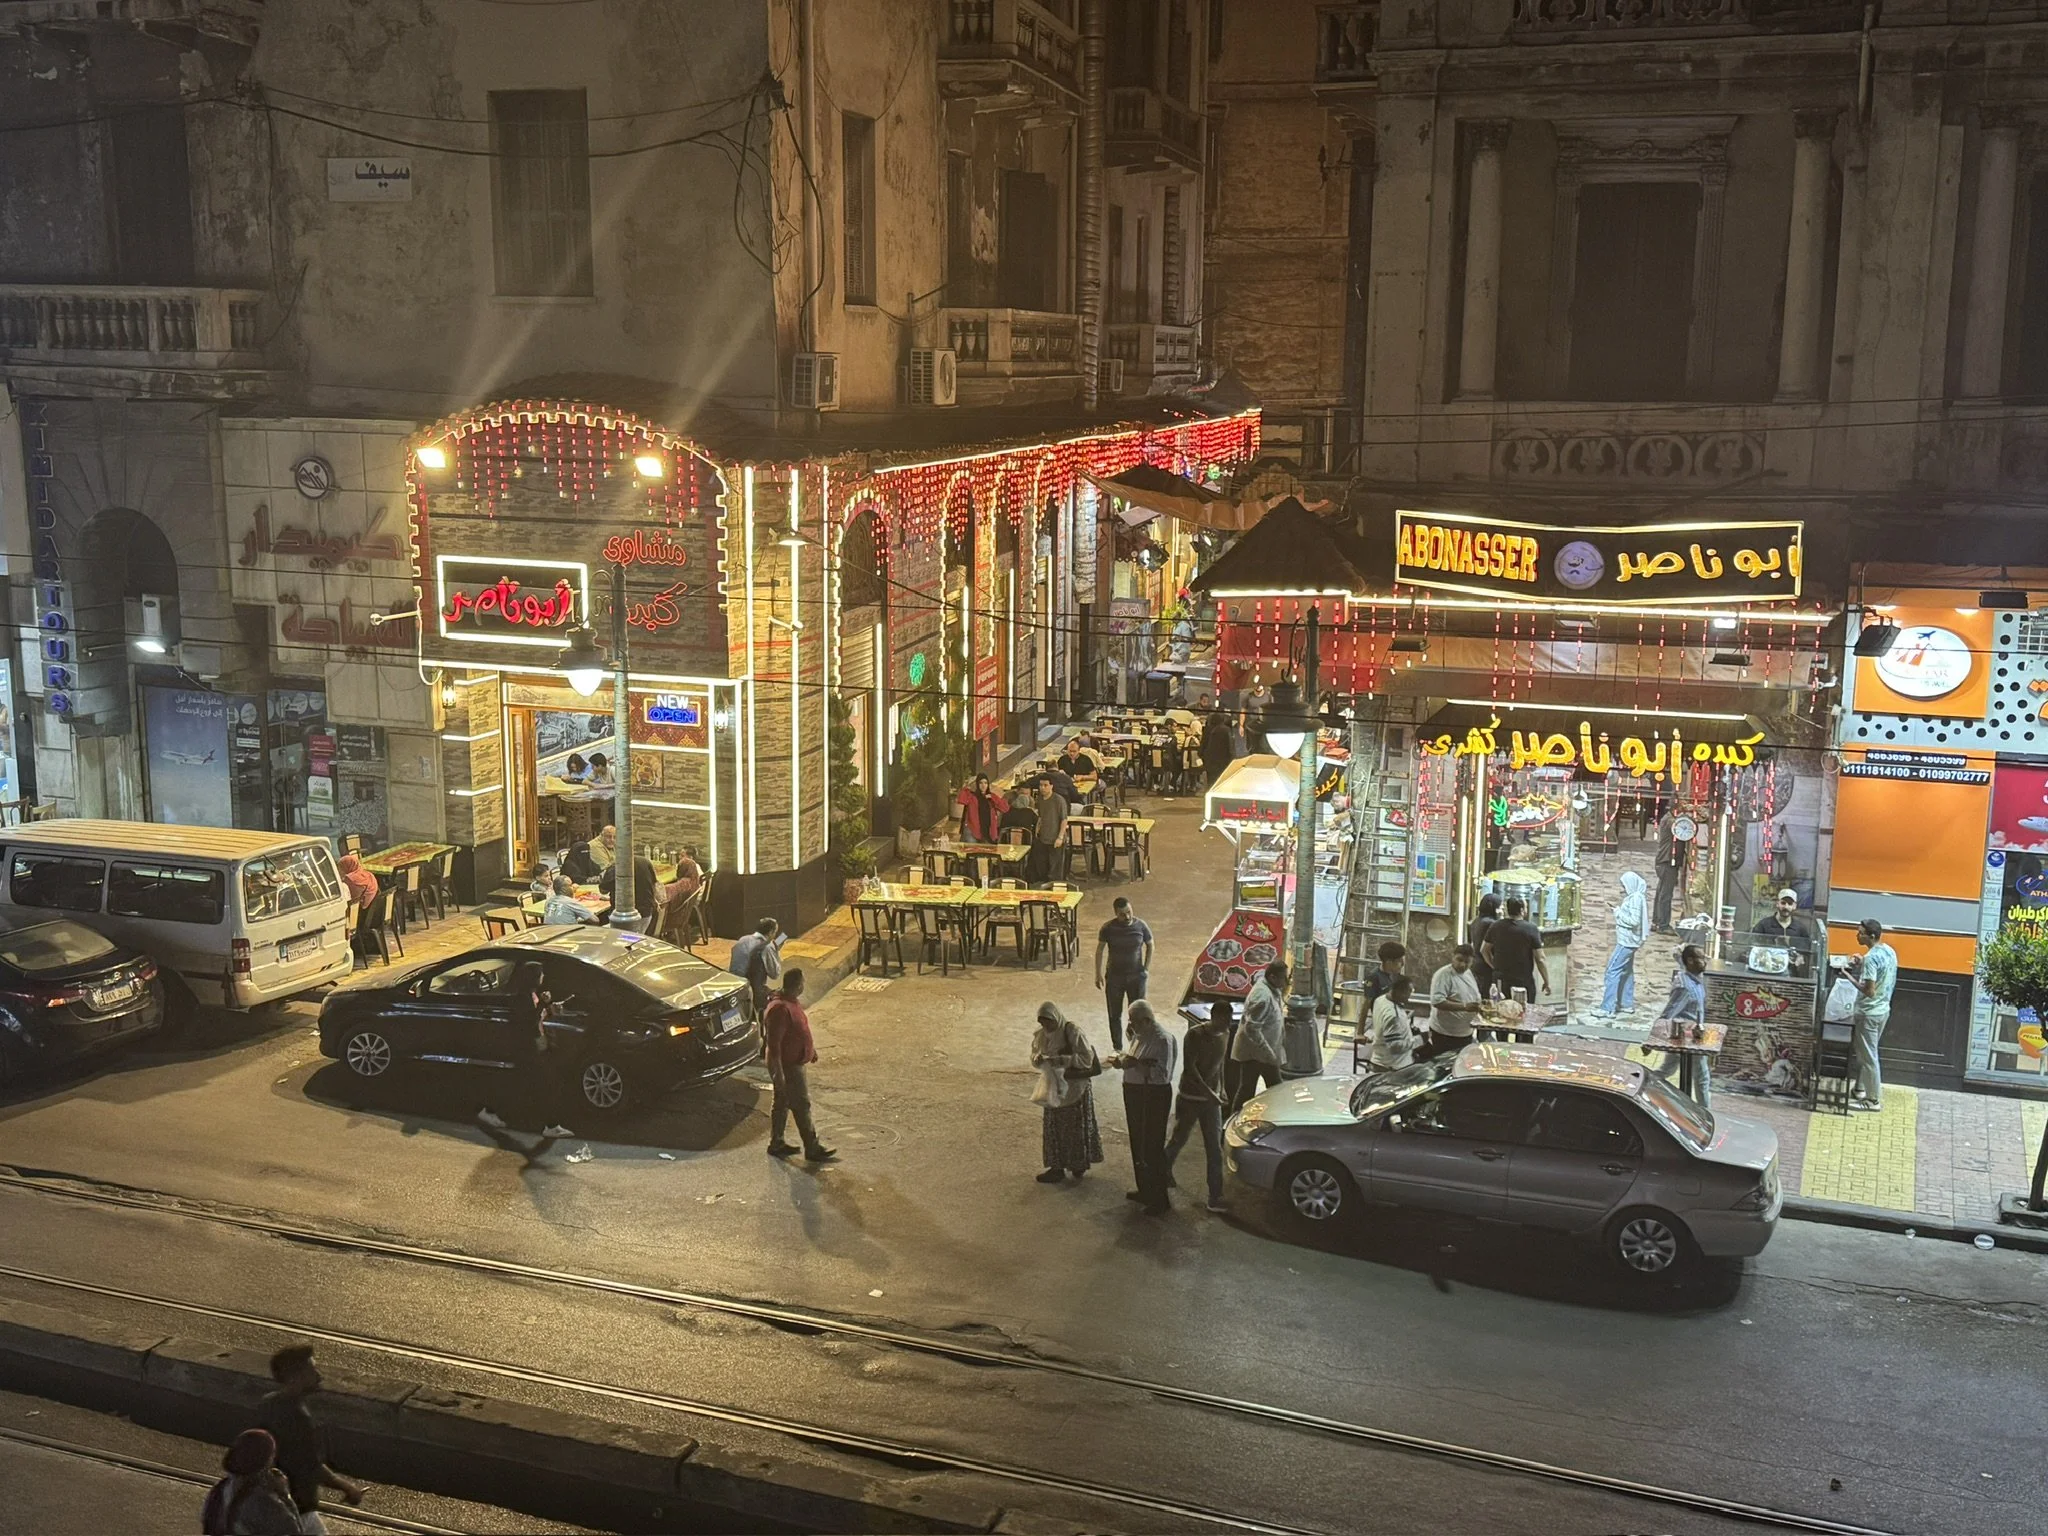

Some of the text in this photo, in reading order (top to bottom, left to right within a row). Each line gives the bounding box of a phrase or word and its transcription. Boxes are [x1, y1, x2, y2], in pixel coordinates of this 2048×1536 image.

[355, 161, 410, 188] سيف
[239, 504, 405, 573] كيميدار
[1400, 523, 1539, 582] ABONASSER
[1616, 543, 1724, 583] ناصر
[612, 581, 688, 631] كبد
[42, 583, 70, 713] TOURS
[648, 707, 696, 723] OPEN
[656, 695, 689, 708] NEW
[1510, 720, 1612, 773] ناصر
[1620, 728, 1682, 785] أبو
[1919, 770, 1989, 782] 01099702777
[2008, 904, 2035, 922] طيران
